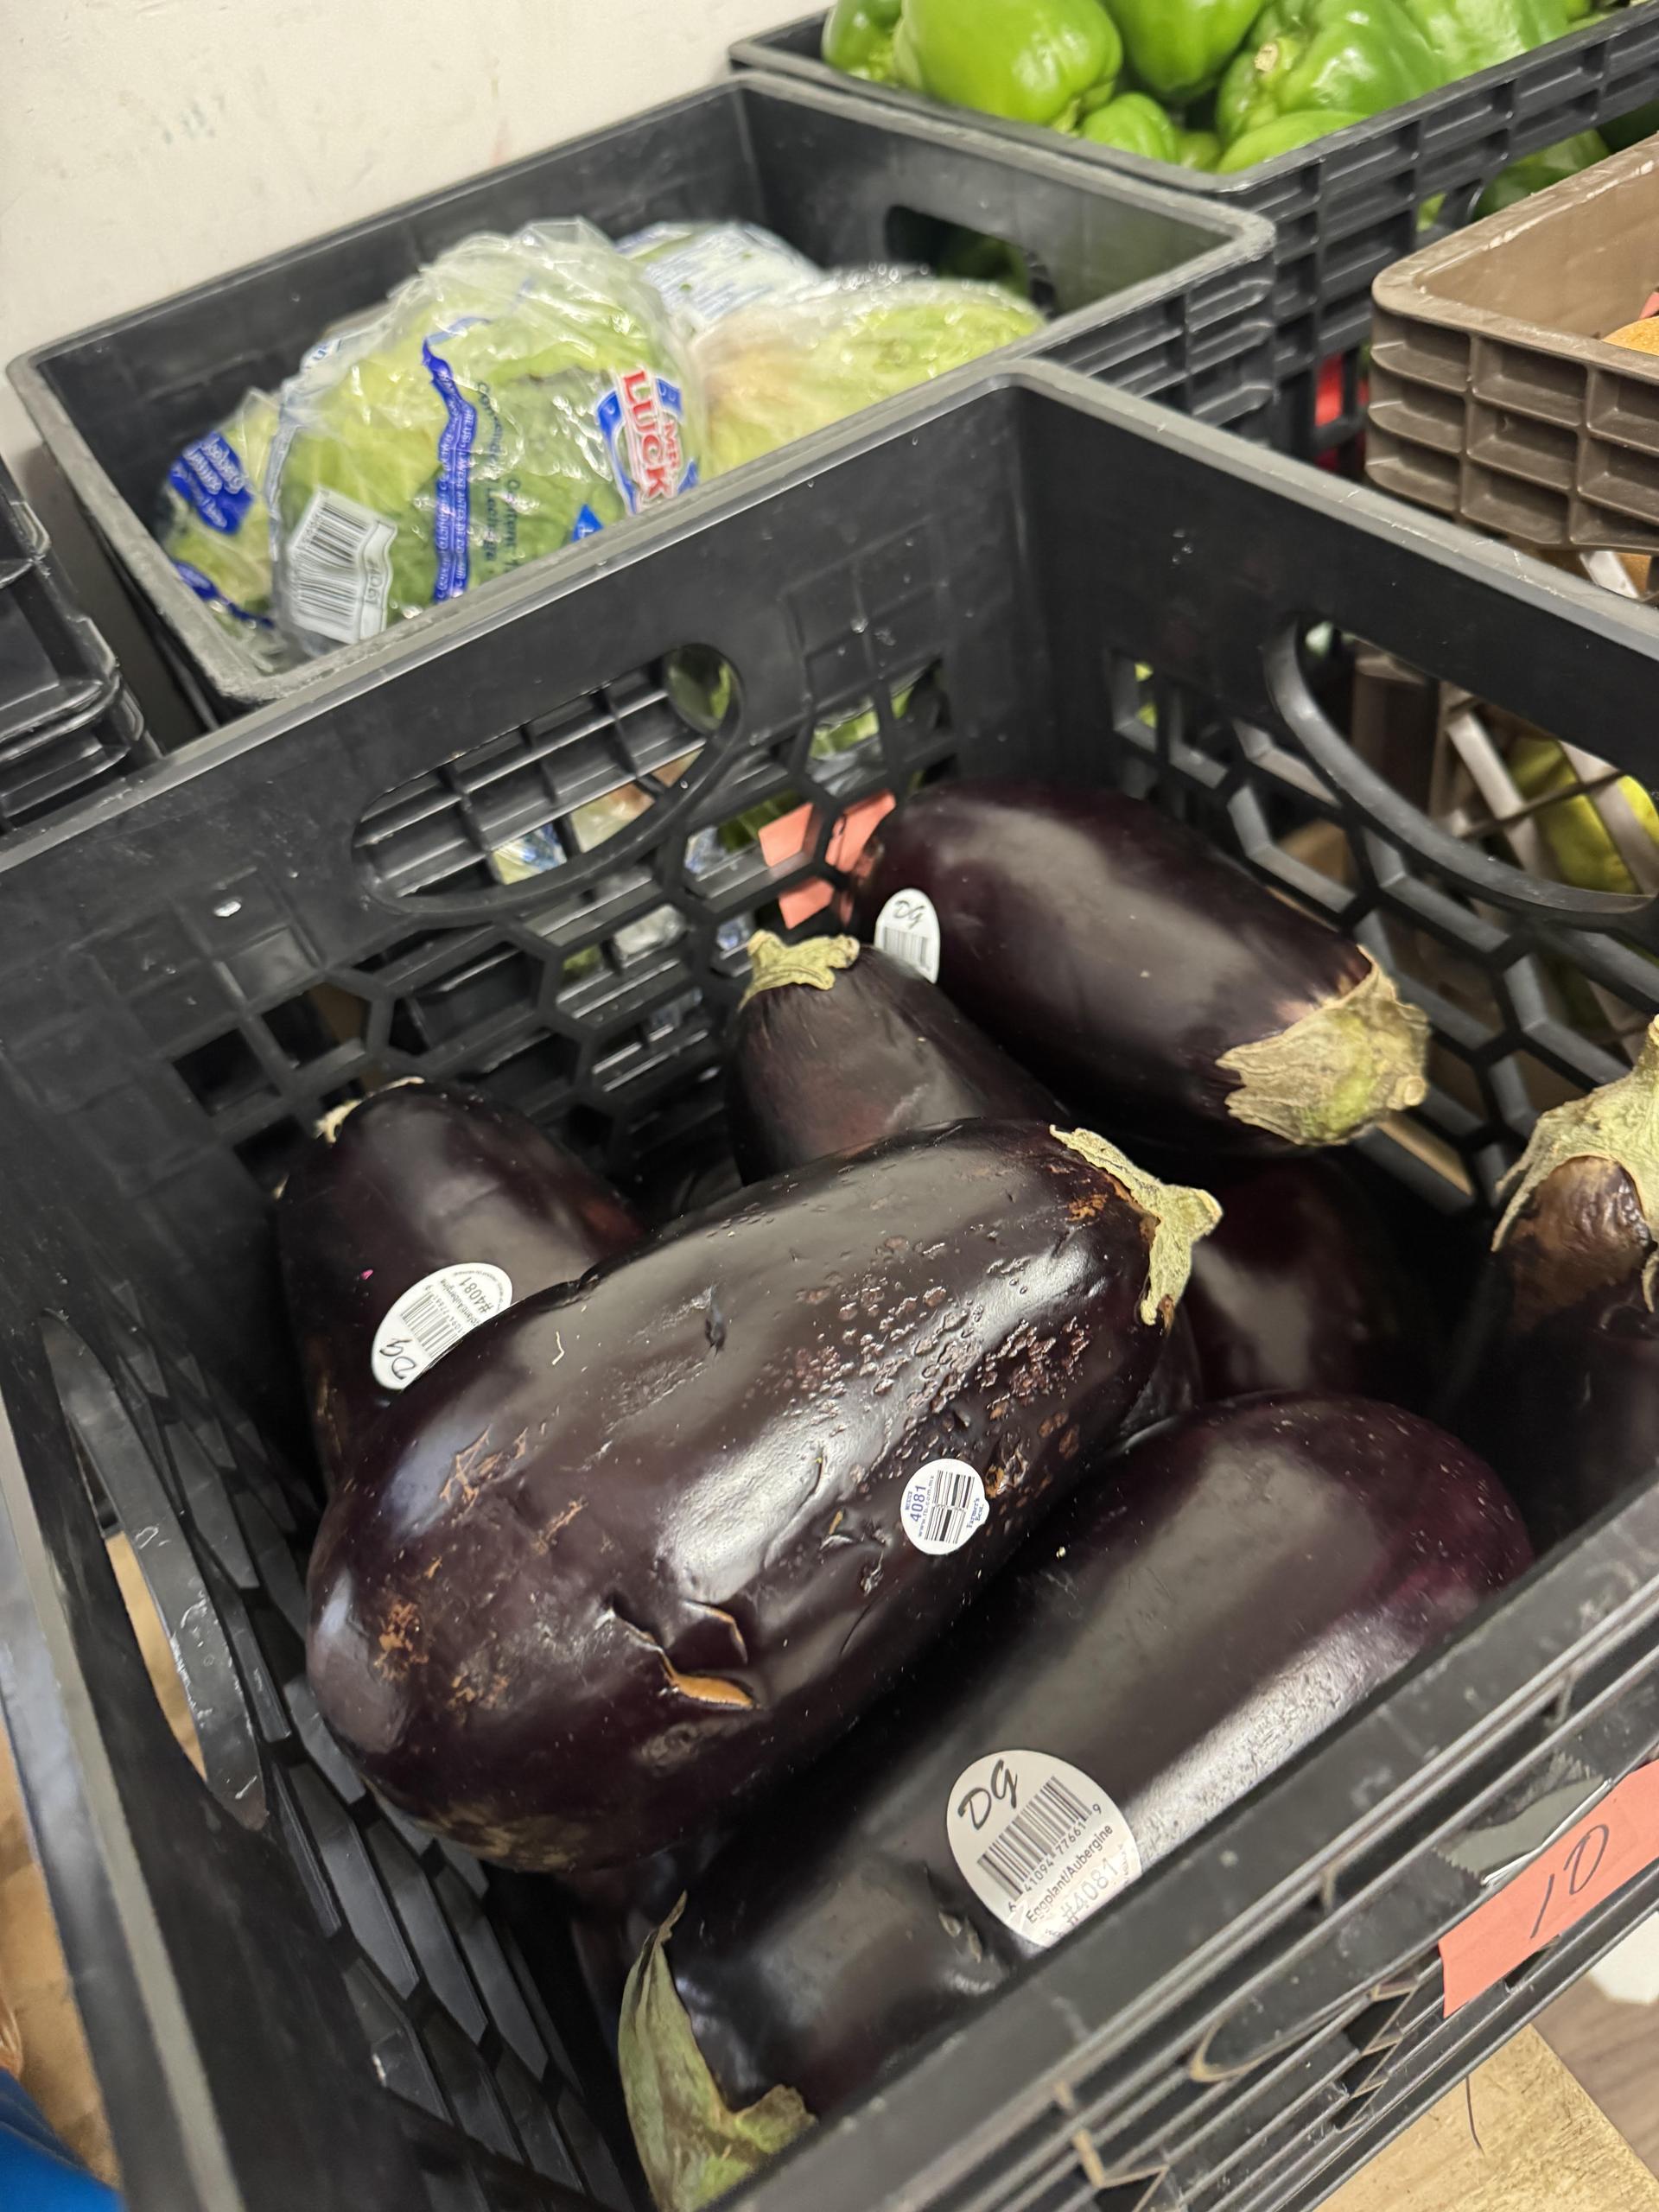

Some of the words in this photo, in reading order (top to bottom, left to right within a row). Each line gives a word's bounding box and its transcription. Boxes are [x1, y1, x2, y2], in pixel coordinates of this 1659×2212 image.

[623, 370, 675, 499] LUCK
[893, 899, 925, 930] DG
[459, 1276, 496, 1314] #4081
[379, 1338, 416, 1381] DG
[910, 1484, 926, 1522] 4081
[966, 1497, 980, 1529] Farmer's
[957, 1758, 1020, 1831] DG
[1024, 1853, 1054, 1892] 41094
[1055, 1821, 1088, 1856] 77661
[1092, 1802, 1103, 1815] 9
[1025, 1824, 1114, 1925] Eggplant/Aubergine
[1529, 1824, 1610, 1940] 10
[1061, 1857, 1119, 1927] #4081
